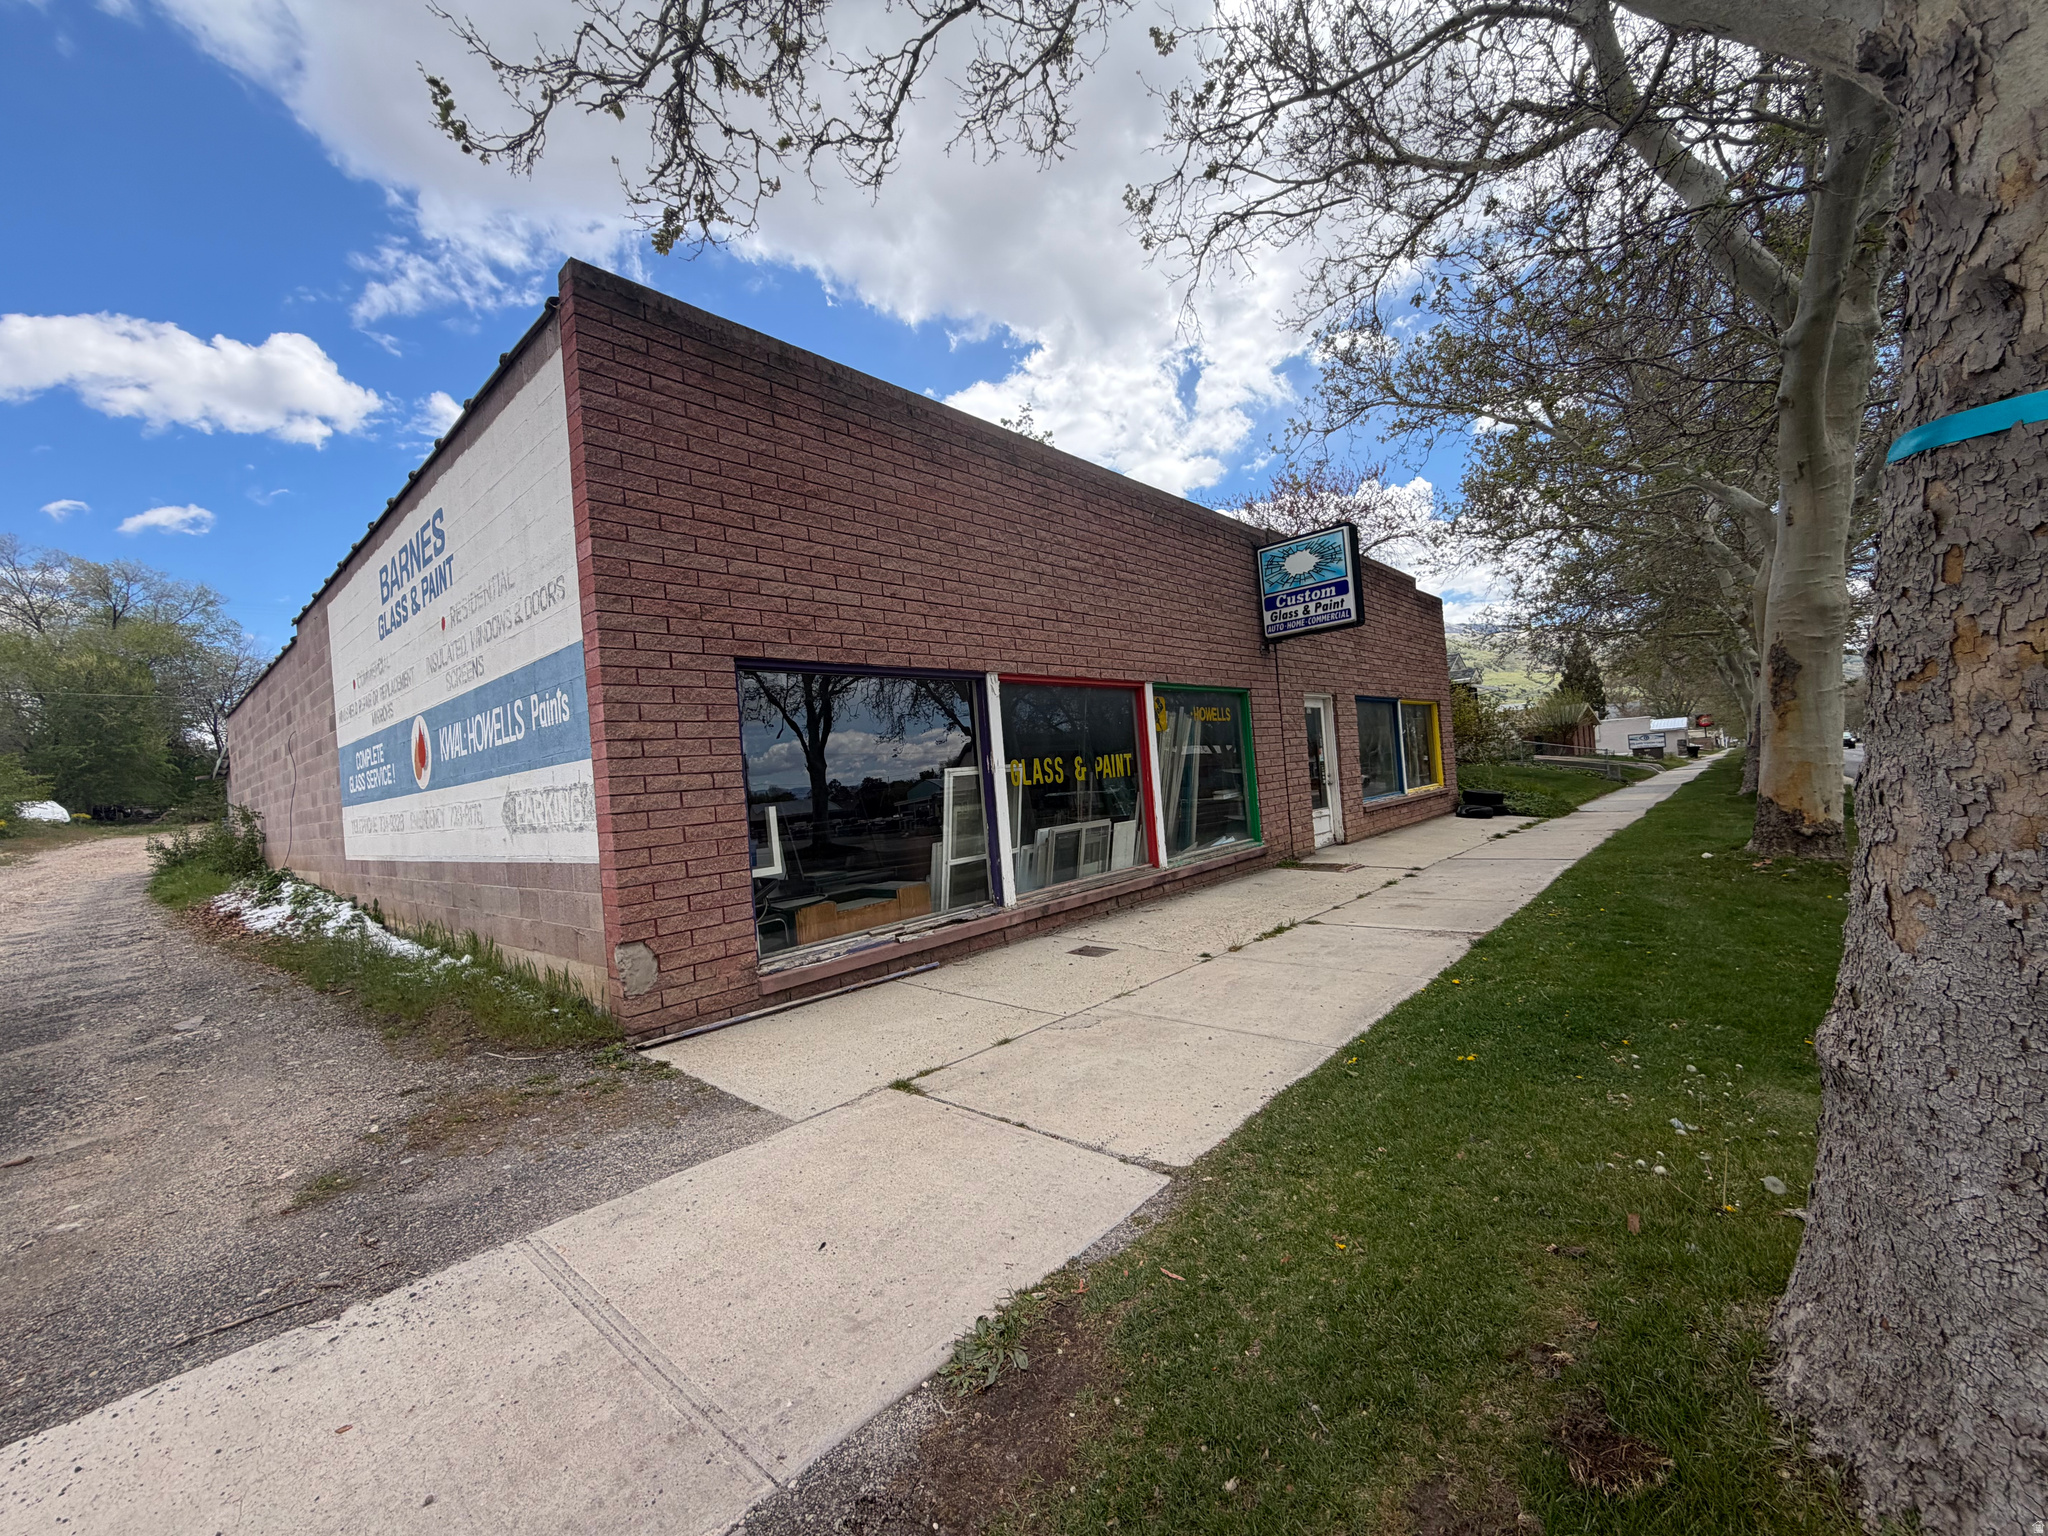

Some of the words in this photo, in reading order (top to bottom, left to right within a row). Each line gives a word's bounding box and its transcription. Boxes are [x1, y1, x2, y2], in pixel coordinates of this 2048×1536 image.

[379, 507, 446, 605] BARNES
[378, 596, 409, 641] GLASS
[410, 588, 421, 616] &
[421, 553, 454, 607] PAINT
[450, 567, 515, 628] RESIDENTIAL
[469, 608, 513, 652] WINDOWS
[514, 603, 524, 626] &
[524, 575, 566, 620] DOORS
[1270, 610, 1298, 622] Glass
[1302, 604, 1310, 616] &
[1314, 598, 1345, 613] Paint
[1276, 586, 1336, 608] Custom
[1267, 624, 1284, 633] AUTO
[1287, 619, 1305, 629] HOME
[1308, 610, 1350, 625] COMMERCIAL
[446, 655, 486, 692] SCREENS
[530, 688, 570, 731] Paints
[355, 743, 384, 771] COMPLETE
[1010, 757, 1064, 786] GLASS
[1074, 756, 1087, 781] &
[1095, 753, 1132, 779] PAINT
[349, 773, 366, 794] GLASS
[515, 791, 584, 824] PARKING
